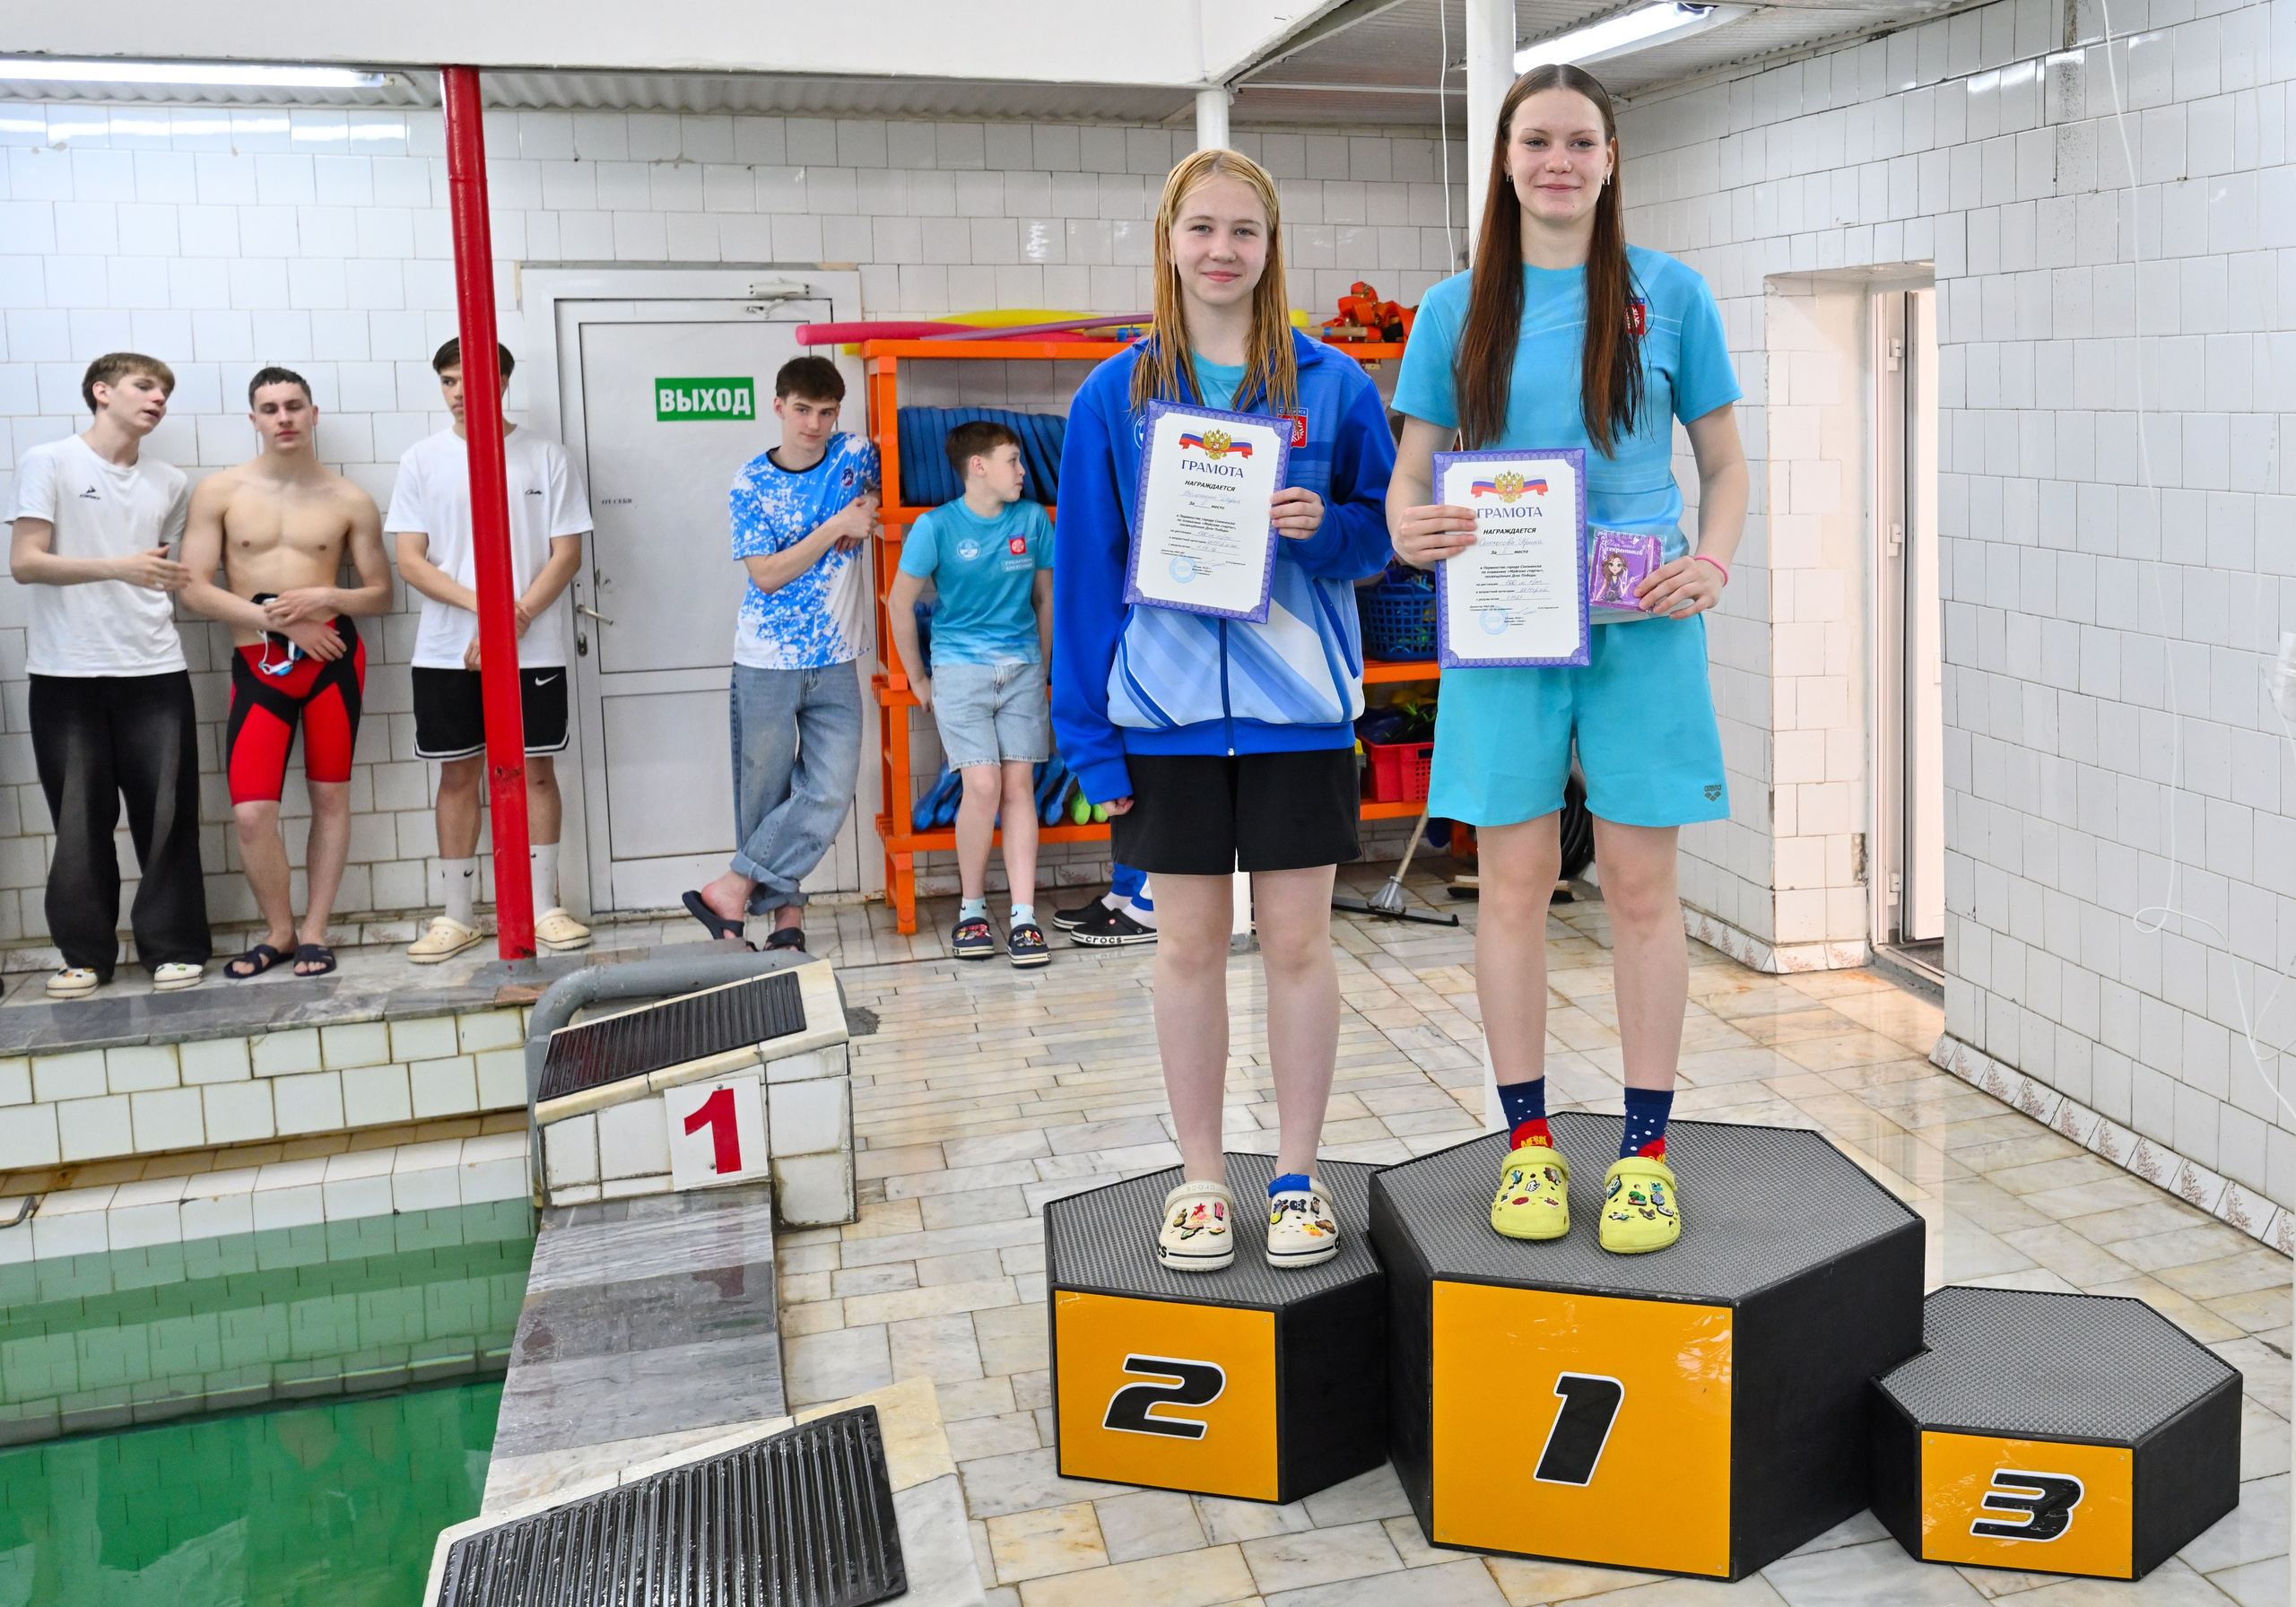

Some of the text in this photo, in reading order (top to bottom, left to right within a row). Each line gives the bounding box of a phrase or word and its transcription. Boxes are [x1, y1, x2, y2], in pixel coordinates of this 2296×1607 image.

[659, 387, 752, 415] ВЫХОД
[1181, 459, 1244, 478] ГРАМОТА
[1184, 480, 1236, 491] НАГРАЖДАЕТСЯ
[1476, 506, 1543, 518] ГРАМОТА
[1085, 935, 1122, 944] crocs
[684, 1088, 742, 1175] 1
[1103, 1355, 1225, 1438] 2
[1534, 1371, 1624, 1487] 1
[1970, 1469, 2084, 1542] 3
